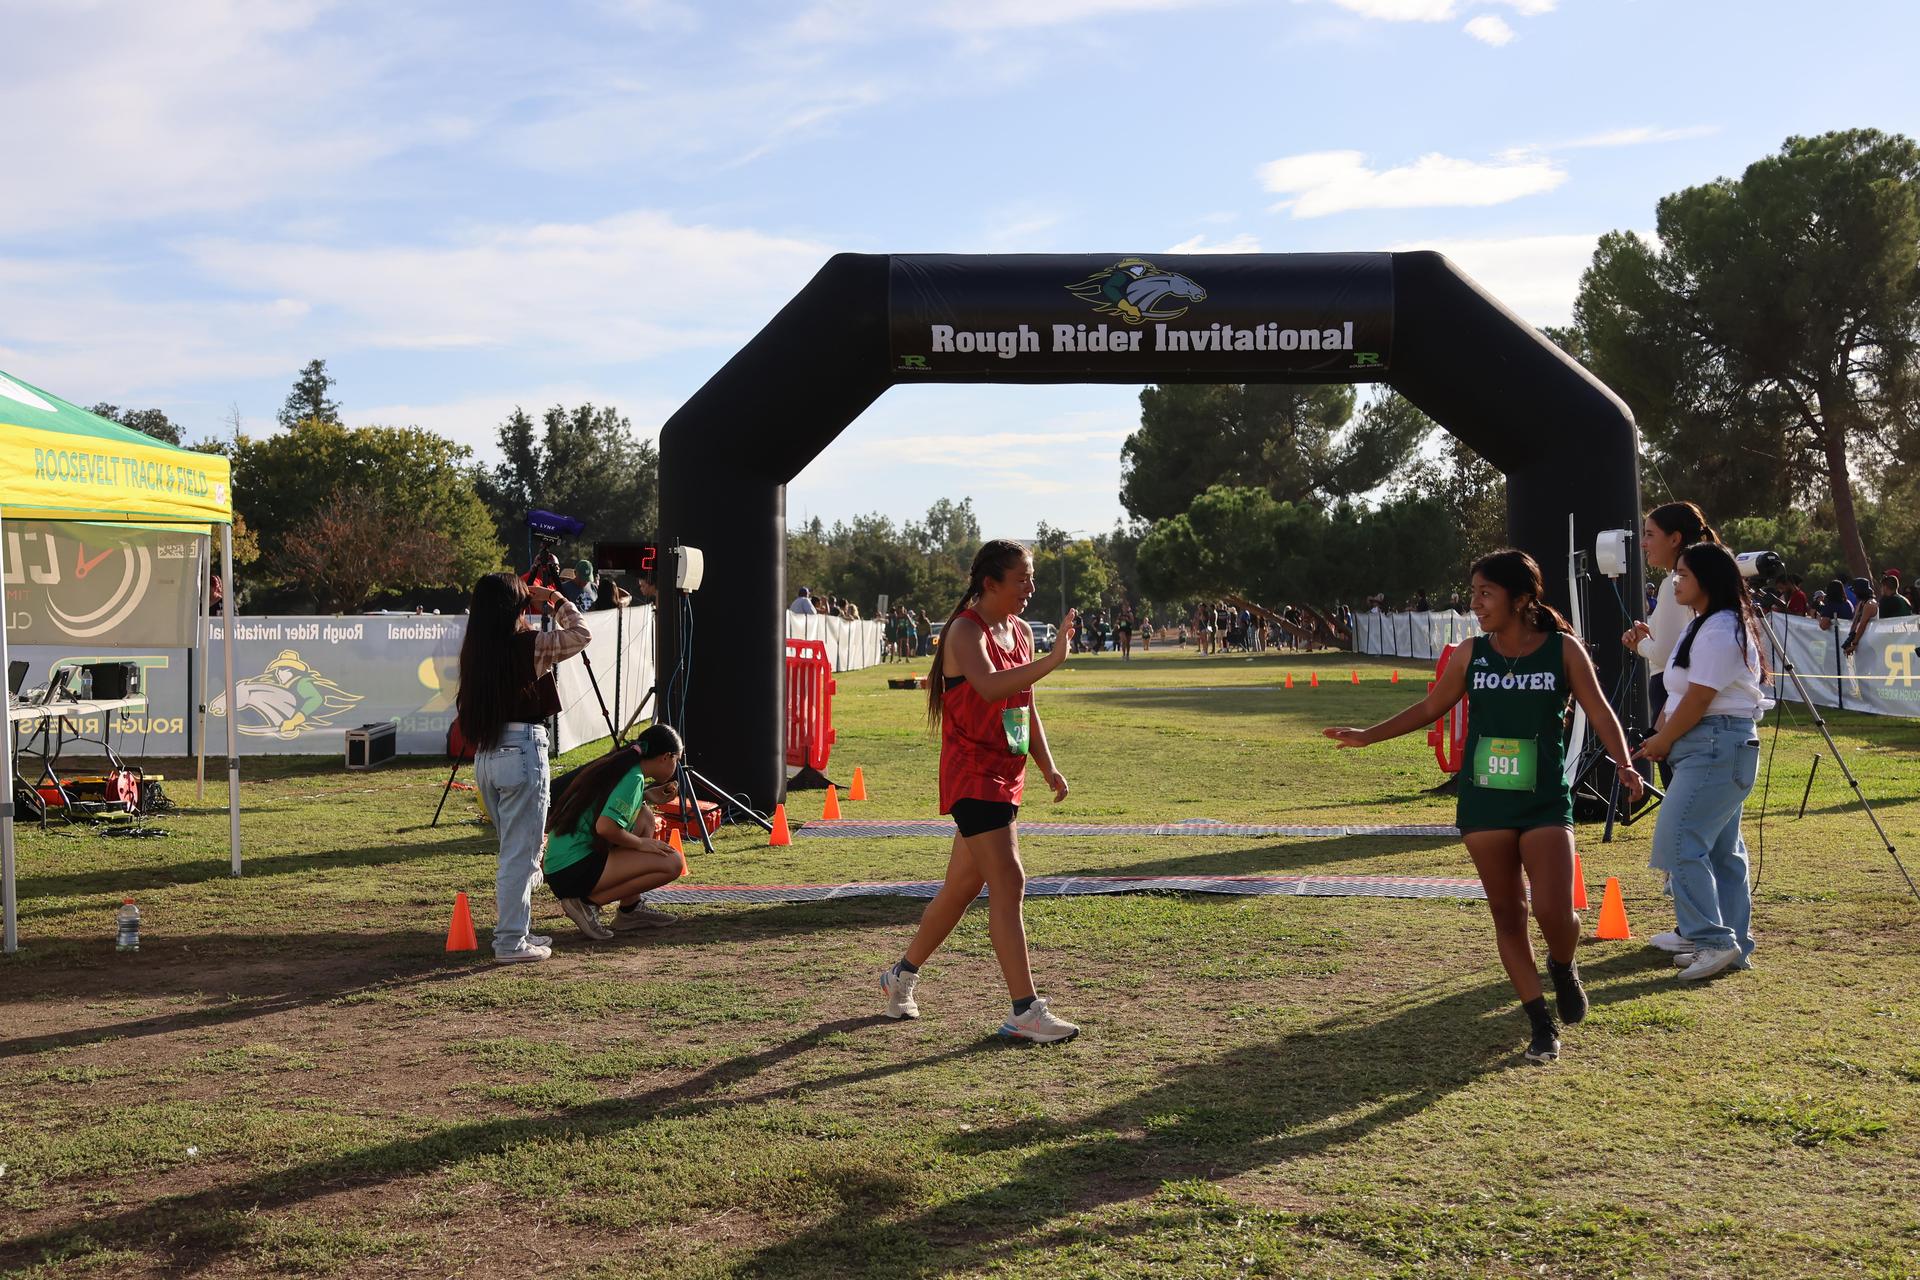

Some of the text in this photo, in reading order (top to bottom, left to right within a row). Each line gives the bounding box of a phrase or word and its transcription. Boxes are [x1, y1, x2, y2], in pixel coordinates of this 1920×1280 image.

[932, 322, 1354, 359] Rough Rider Invitational
[35, 448, 119, 486] ROOSEVELT
[122, 457, 164, 491] TRACK
[166, 465, 175, 492] &
[177, 467, 208, 497] FIELD
[641, 547, 656, 570] 2
[1473, 671, 1555, 691] HOOVER
[1489, 756, 1519, 775] 991
